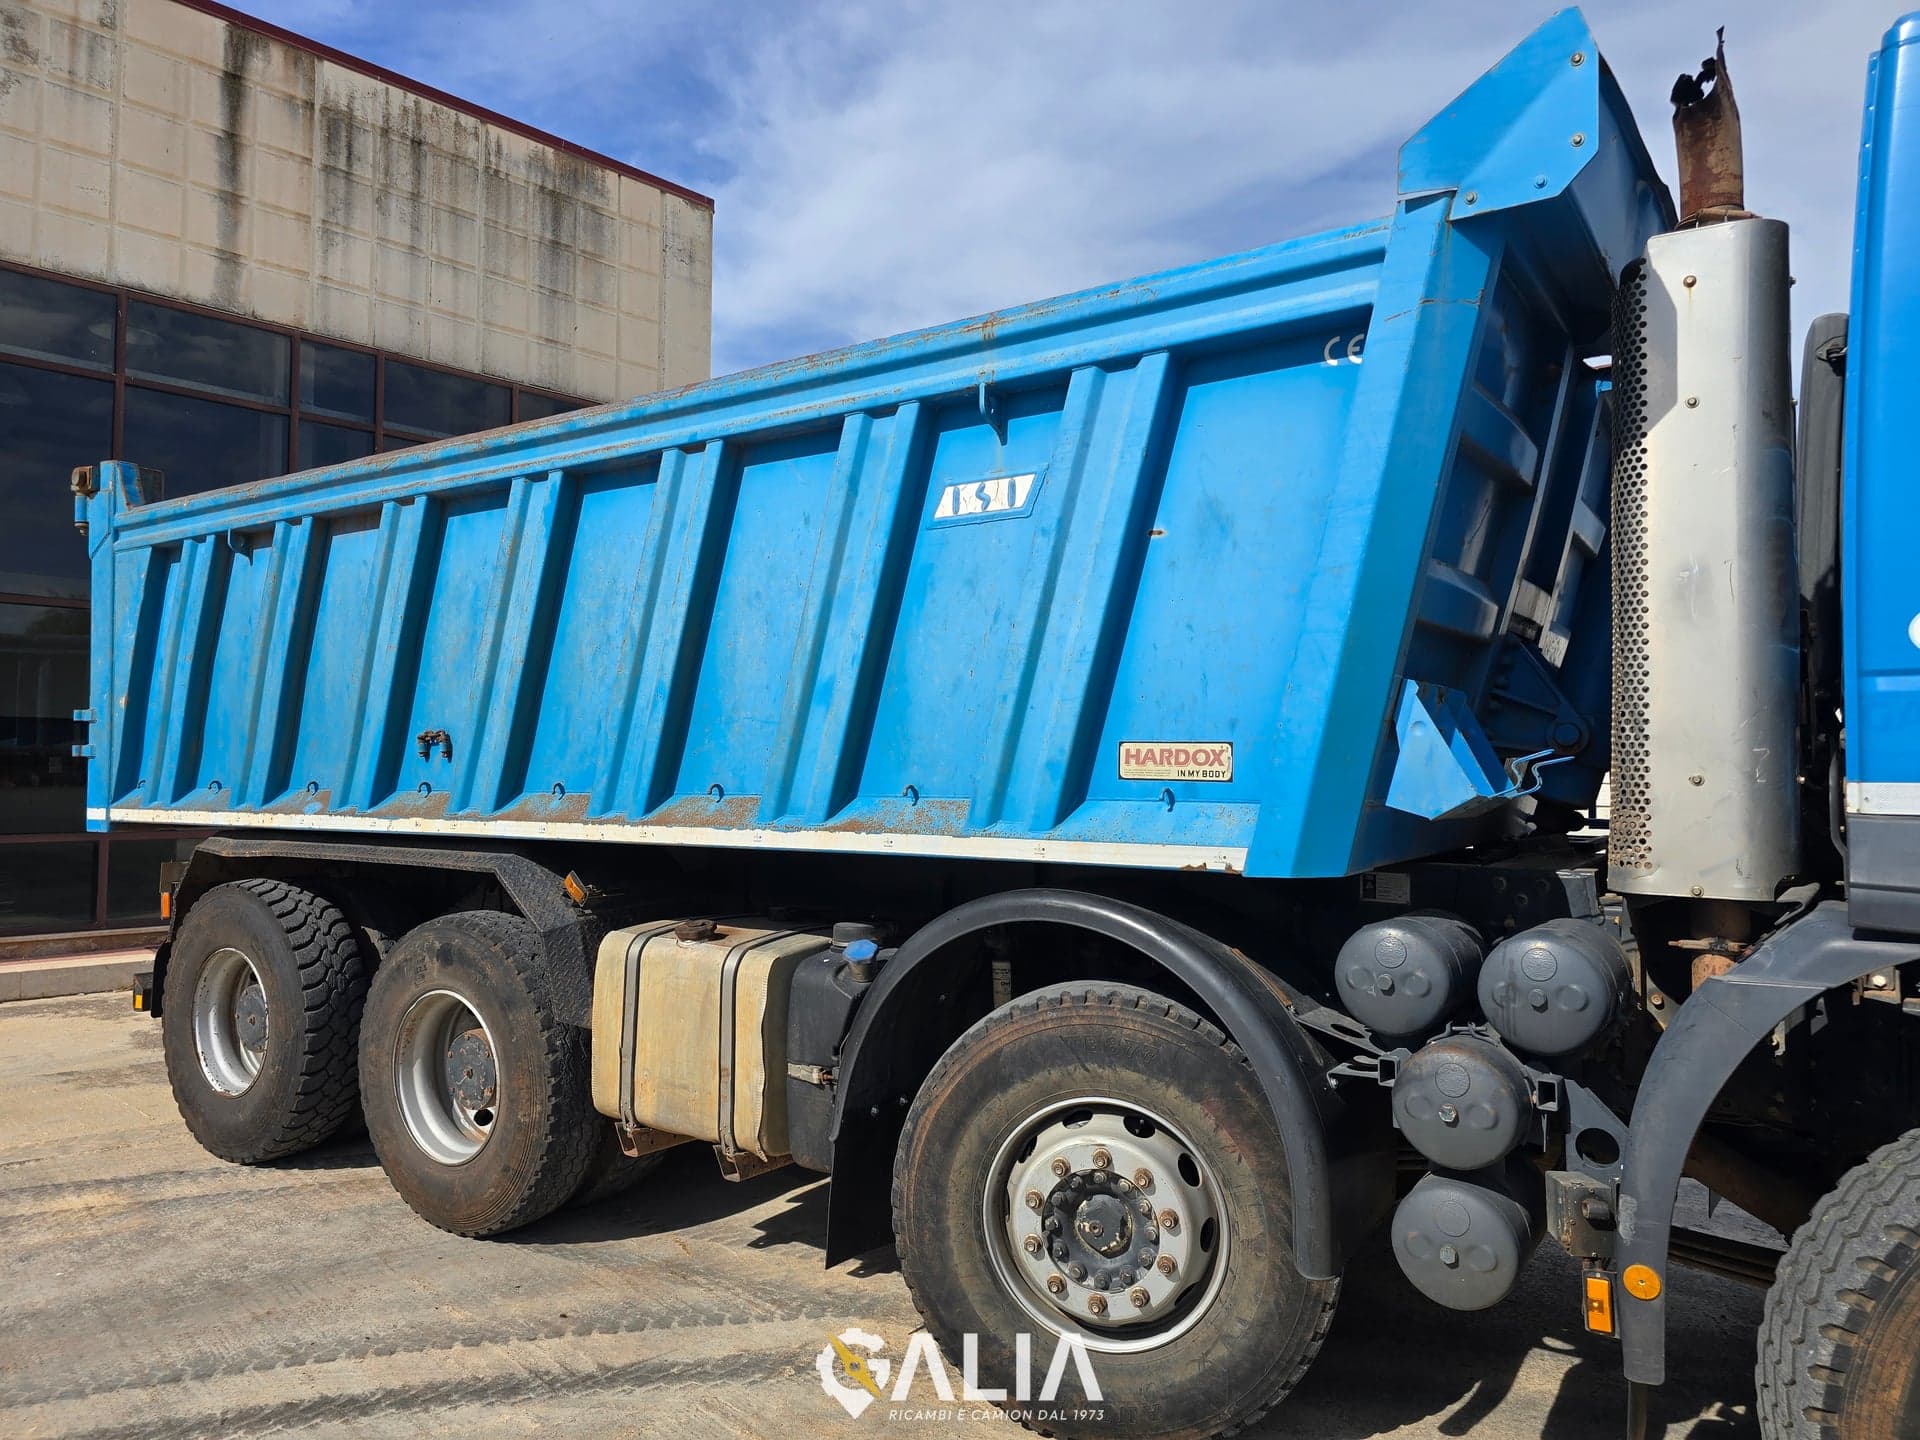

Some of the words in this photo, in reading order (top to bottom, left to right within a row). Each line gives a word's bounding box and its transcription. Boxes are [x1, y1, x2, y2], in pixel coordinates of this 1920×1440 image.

[1324, 333, 1365, 366] CE
[1124, 748, 1226, 767] HARDOX
[1177, 769, 1186, 777] IN
[1188, 769, 1200, 777] MY
[1202, 770, 1226, 778] BODY
